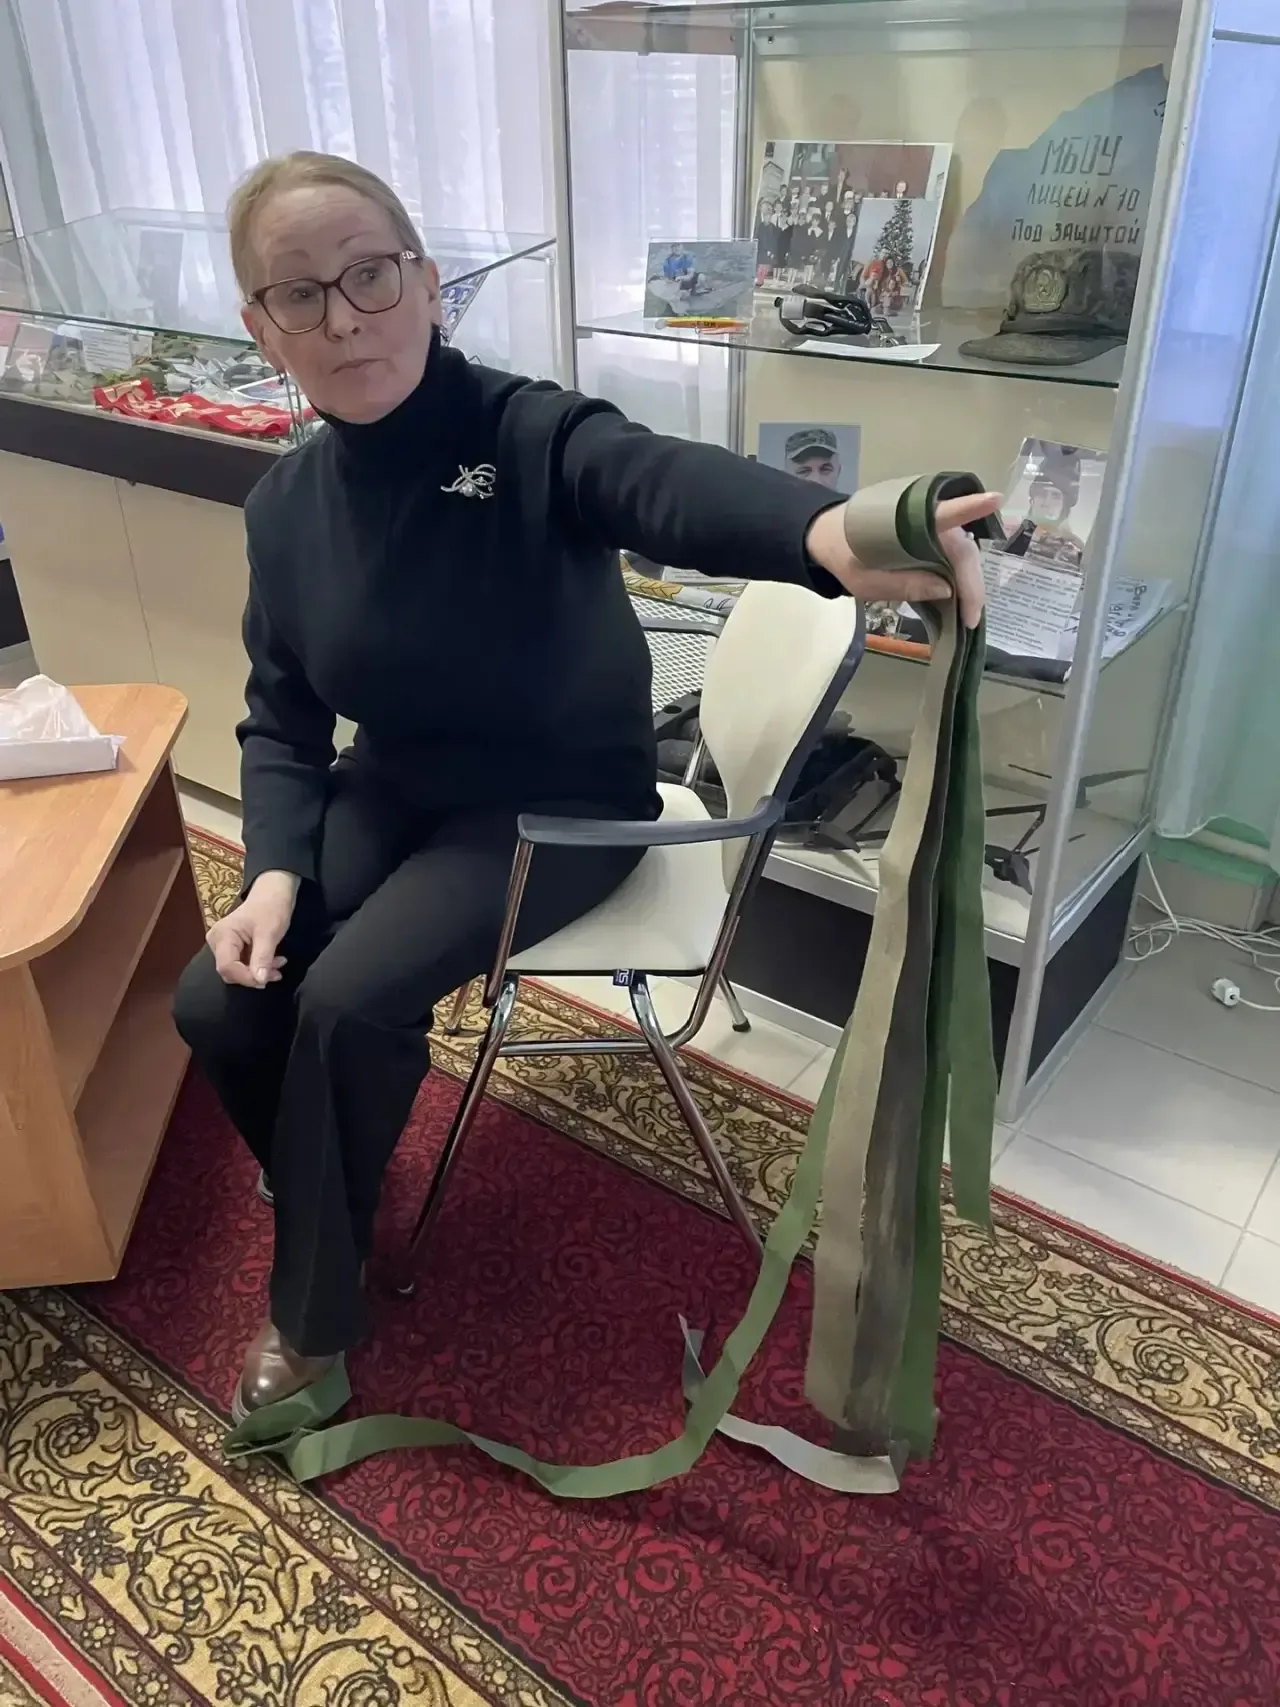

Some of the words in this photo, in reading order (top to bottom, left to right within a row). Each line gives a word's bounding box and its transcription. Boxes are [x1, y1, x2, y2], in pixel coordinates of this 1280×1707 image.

[1040, 135, 1123, 176] МБОУ
[1027, 180, 1091, 209] ЛИЦЕЙ
[1049, 218, 1140, 245] ЗАЩИТОЙ
